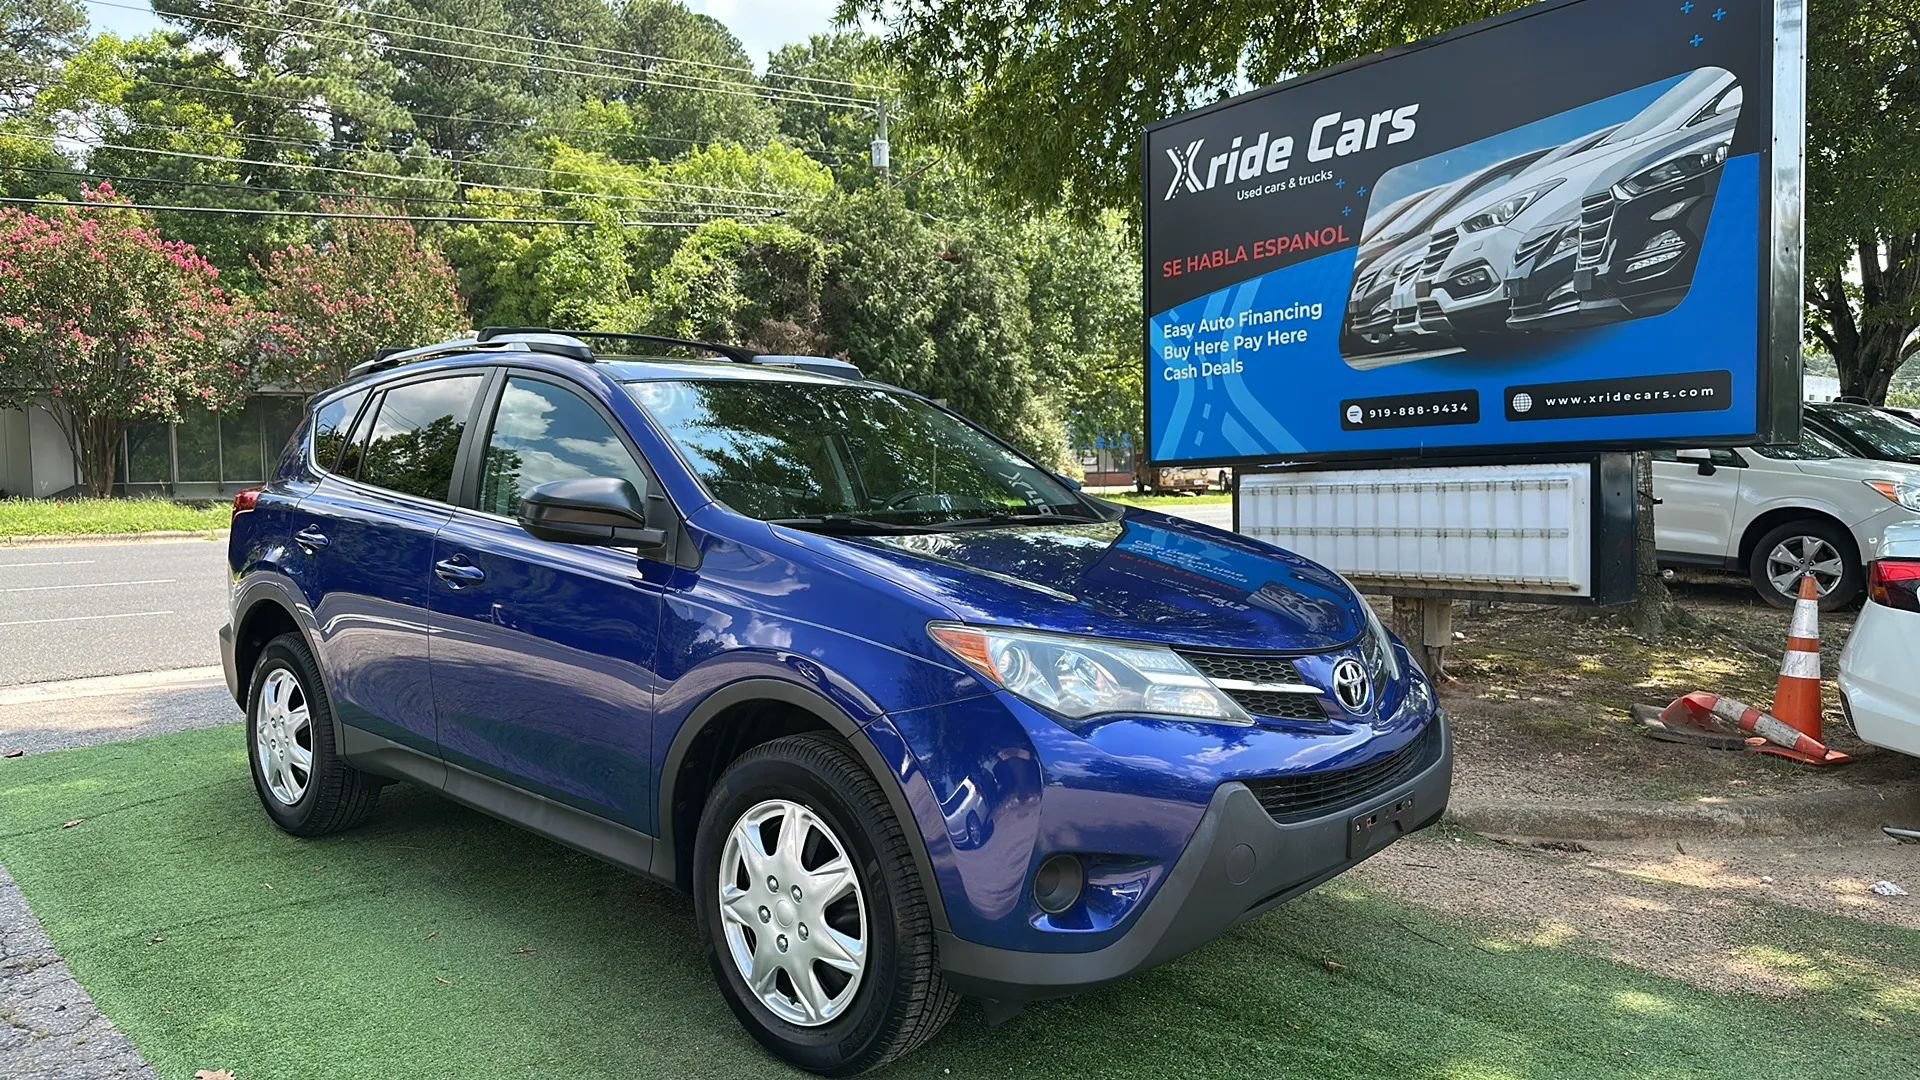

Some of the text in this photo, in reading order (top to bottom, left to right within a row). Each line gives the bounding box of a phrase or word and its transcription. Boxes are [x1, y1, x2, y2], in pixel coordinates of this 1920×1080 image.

[1306, 103, 1419, 163] Cars
[1236, 169, 1333, 201] Used cars & trucks
[1162, 225, 1349, 278] SE HABLA ESPANOL
[1163, 301, 1322, 340] Easy Auto Financing
[1163, 328, 1308, 362] Buy Here Pay Here
[1163, 358, 1243, 381] Cash Deals
[1369, 403, 1468, 418] 919-888-9434
[1545, 387, 1714, 406] www.xridecars.com
